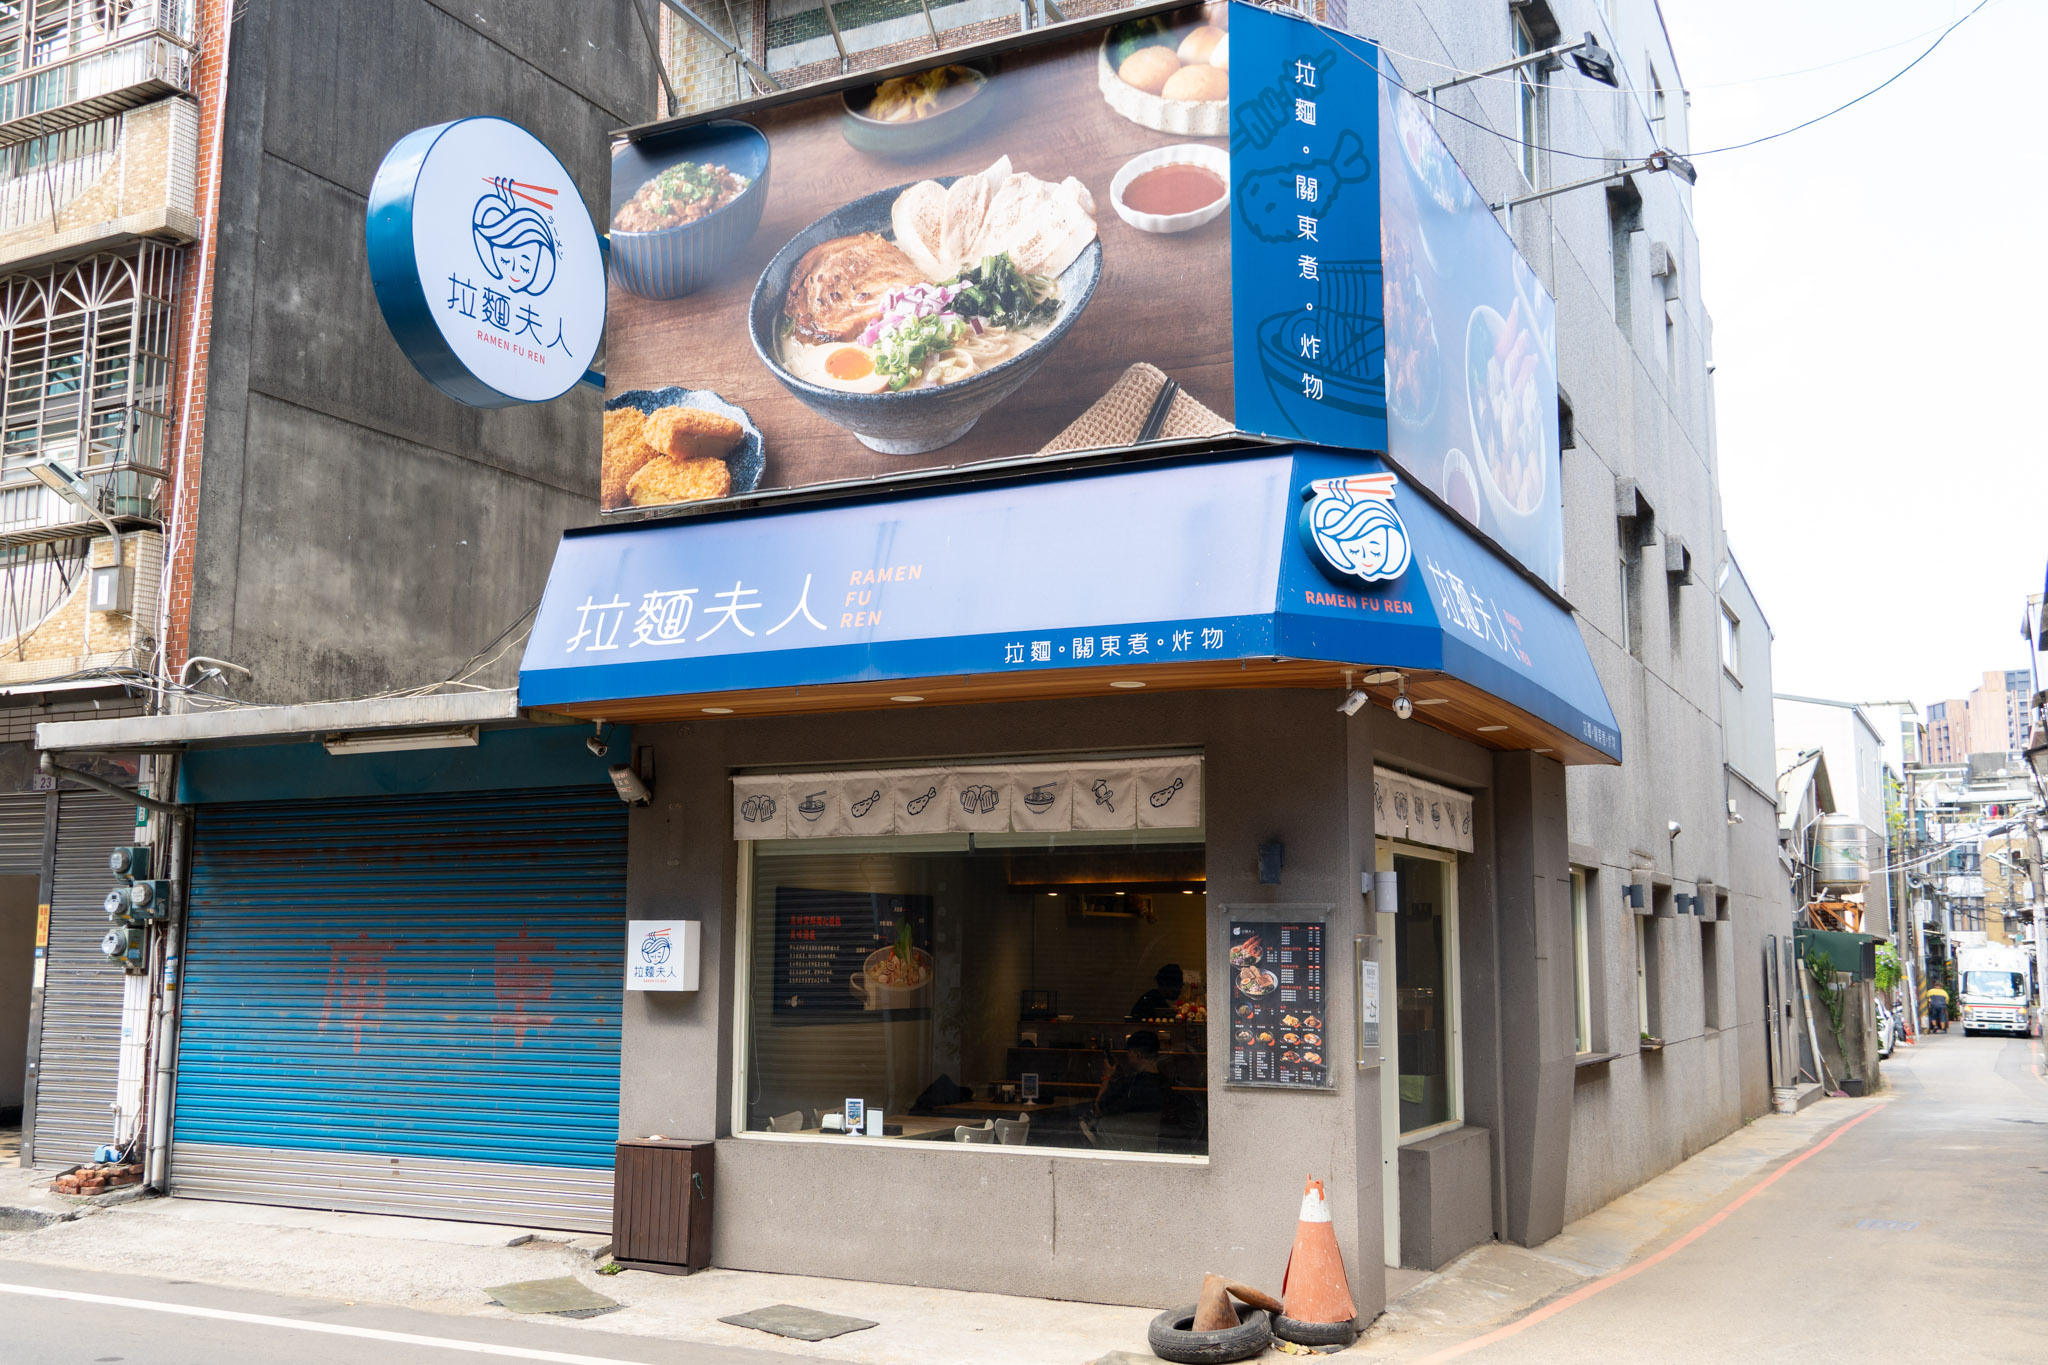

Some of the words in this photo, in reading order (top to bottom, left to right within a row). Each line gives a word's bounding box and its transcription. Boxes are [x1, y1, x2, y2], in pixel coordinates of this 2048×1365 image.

[548, 215, 564, 260] ラーメン
[447, 272, 573, 358] 拉麵夫人
[477, 330, 510, 351] RAMEN
[513, 344, 525, 357] FU
[527, 349, 545, 365] REN
[849, 564, 923, 586] RAMEN
[566, 573, 828, 653] 拉麵夫人
[845, 590, 872, 607] FU
[1305, 590, 1357, 609] RAMEN
[1361, 597, 1380, 612] FU
[1384, 600, 1414, 615] REN
[1427, 554, 1521, 661] 拉麵夫人
[840, 609, 882, 628] REN
[40, 776, 52, 789] 23
